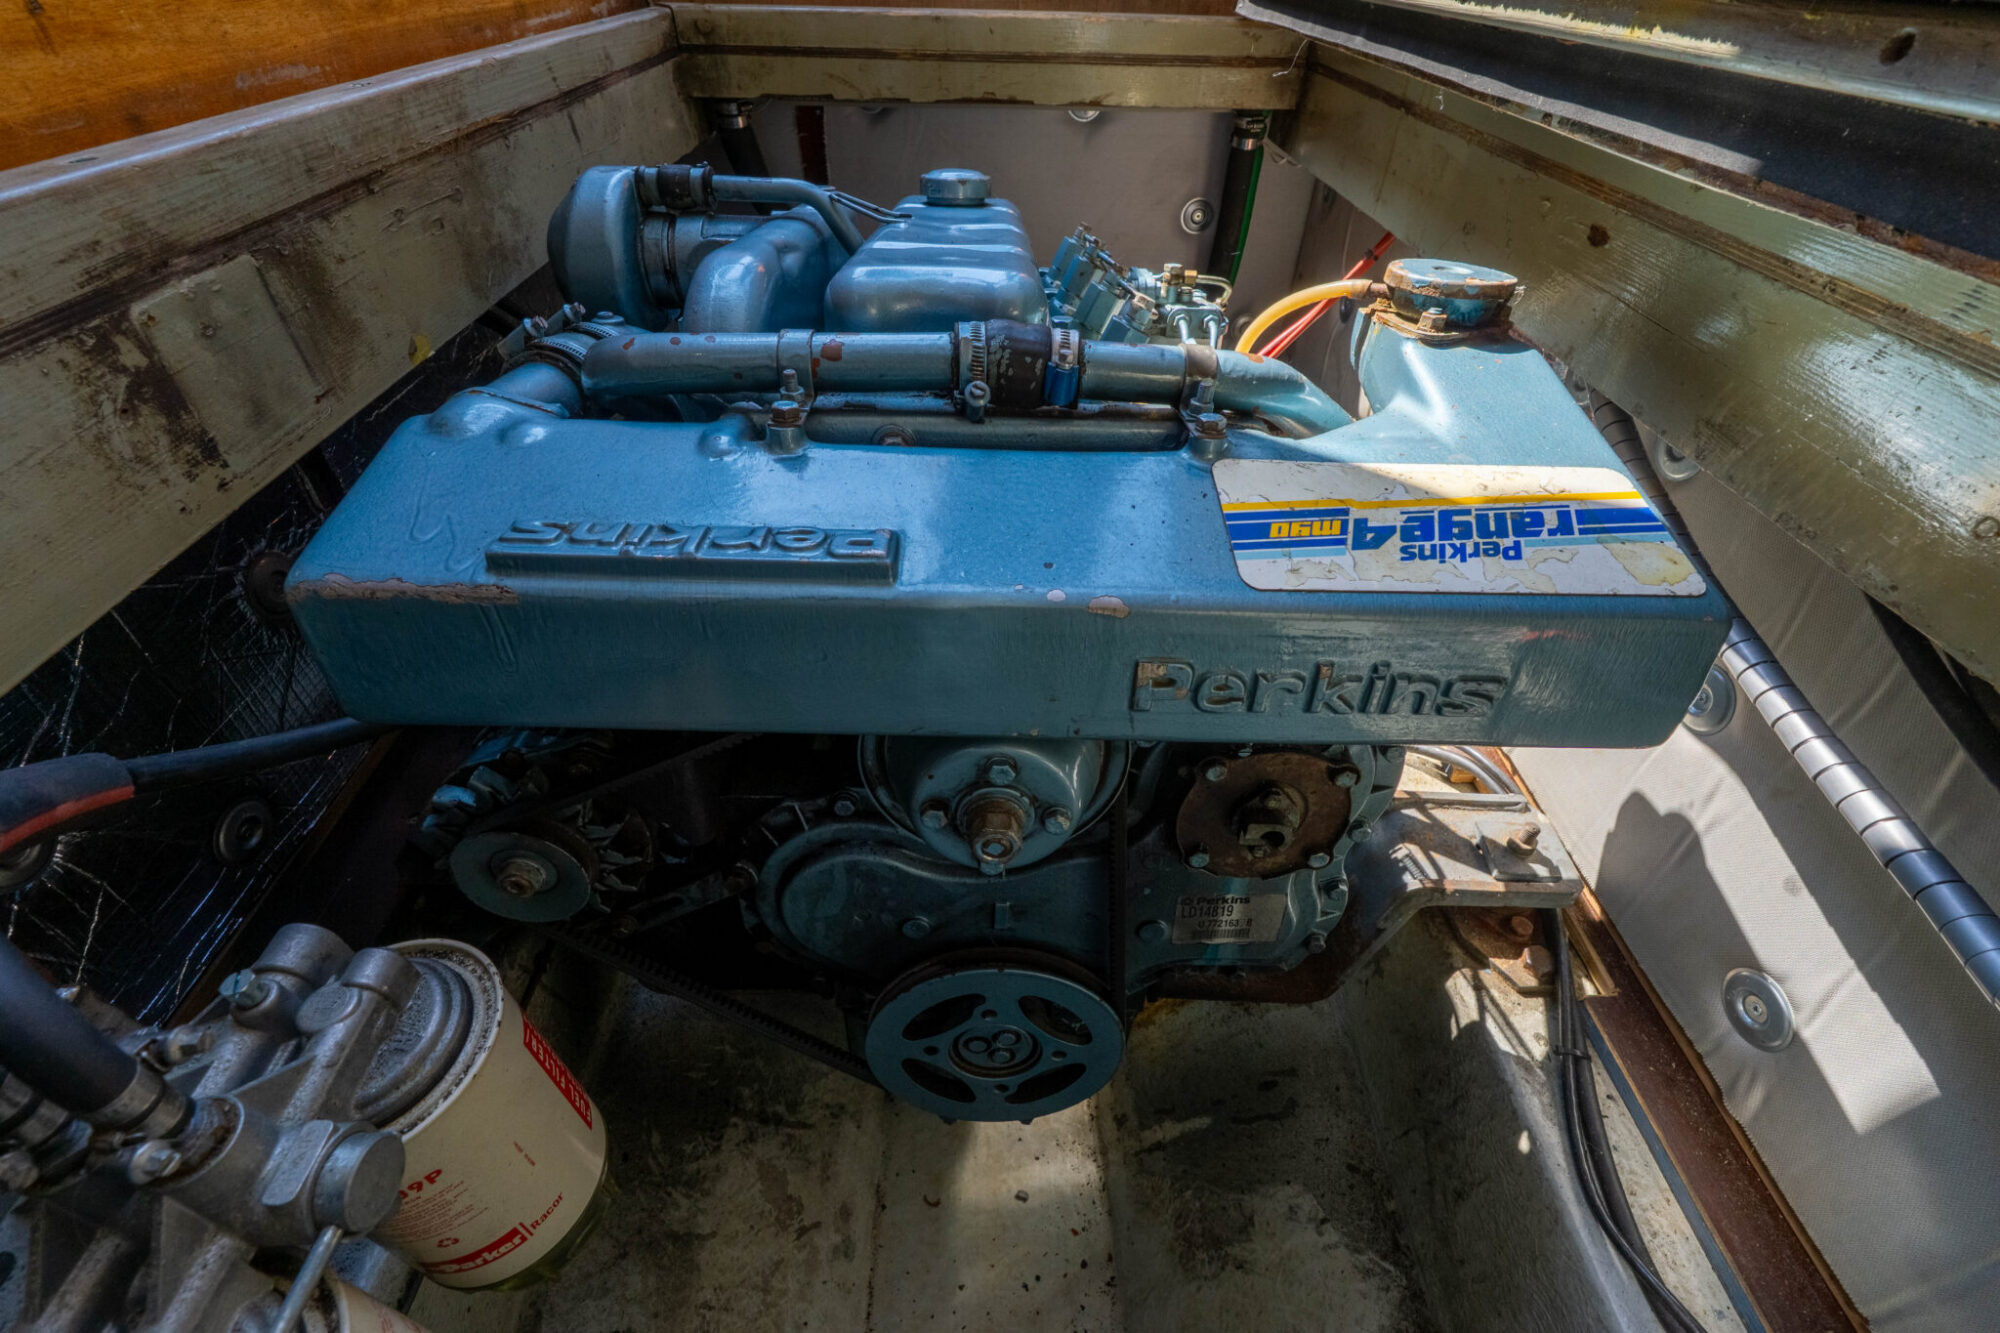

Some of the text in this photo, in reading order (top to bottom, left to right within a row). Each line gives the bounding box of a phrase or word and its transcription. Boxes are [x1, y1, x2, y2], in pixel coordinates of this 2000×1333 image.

[497, 519, 890, 559] Perkins
[1400, 540, 1522, 563] Perkins
[1131, 658, 1506, 714] Perkins
[1181, 904, 1234, 918] LD14819
[1196, 896, 1250, 905] Perkins
[568, 1083, 592, 1122] FUEL
[441, 1233, 525, 1272] Parker
[530, 1192, 564, 1230] Racor
